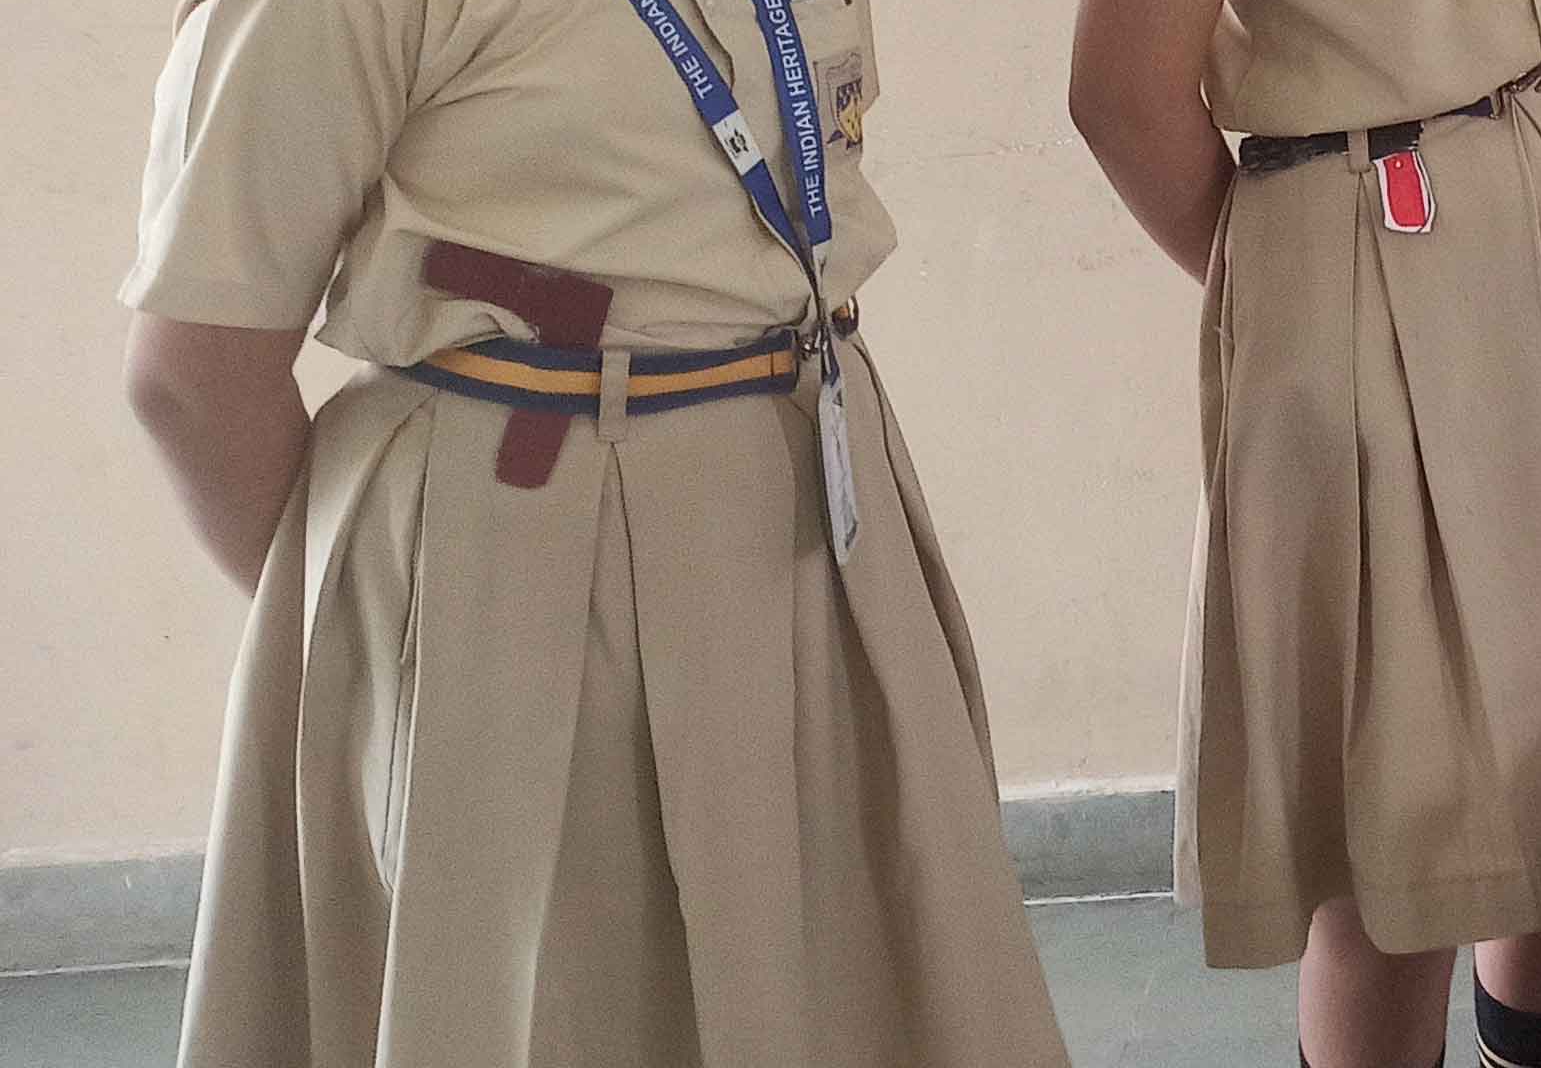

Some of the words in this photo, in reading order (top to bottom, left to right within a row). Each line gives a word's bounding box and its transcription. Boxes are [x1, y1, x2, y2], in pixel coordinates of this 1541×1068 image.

[681, 54, 714, 101] THE
[791, 102, 820, 172] INDIAN
[804, 172, 823, 219] THE
